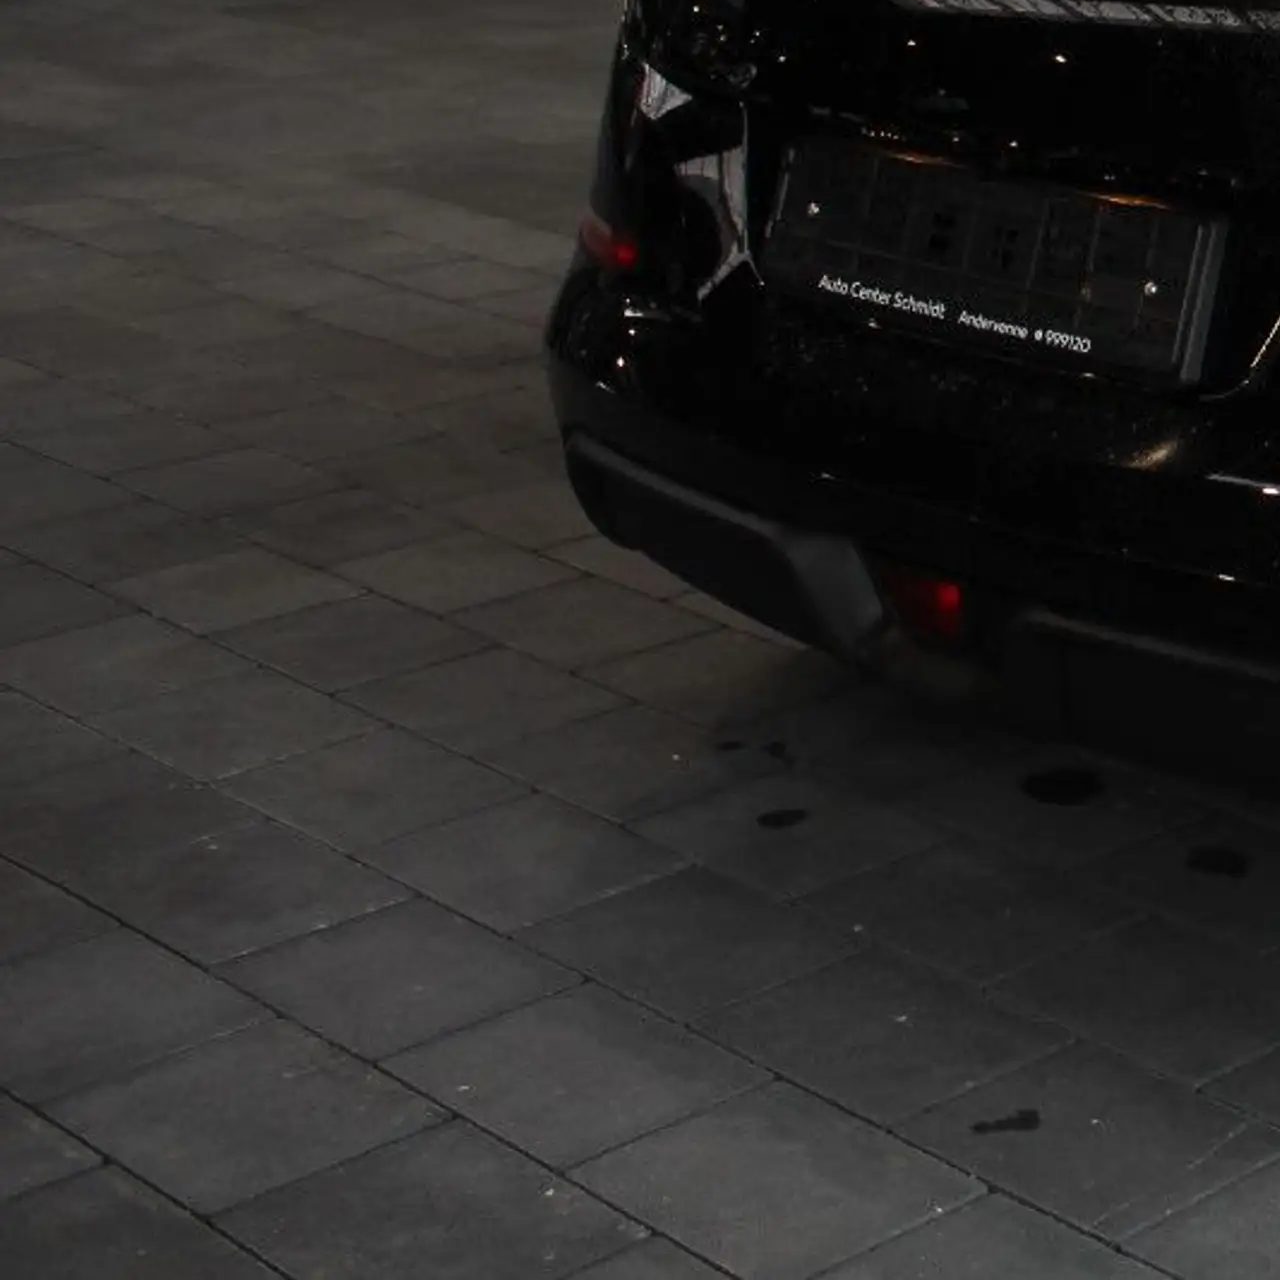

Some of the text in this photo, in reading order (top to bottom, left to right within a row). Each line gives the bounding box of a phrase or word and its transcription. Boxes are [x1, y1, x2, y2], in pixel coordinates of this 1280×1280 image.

[818, 273, 850, 297] Auto
[850, 280, 892, 306] Center
[892, 290, 946, 320] Schmidt
